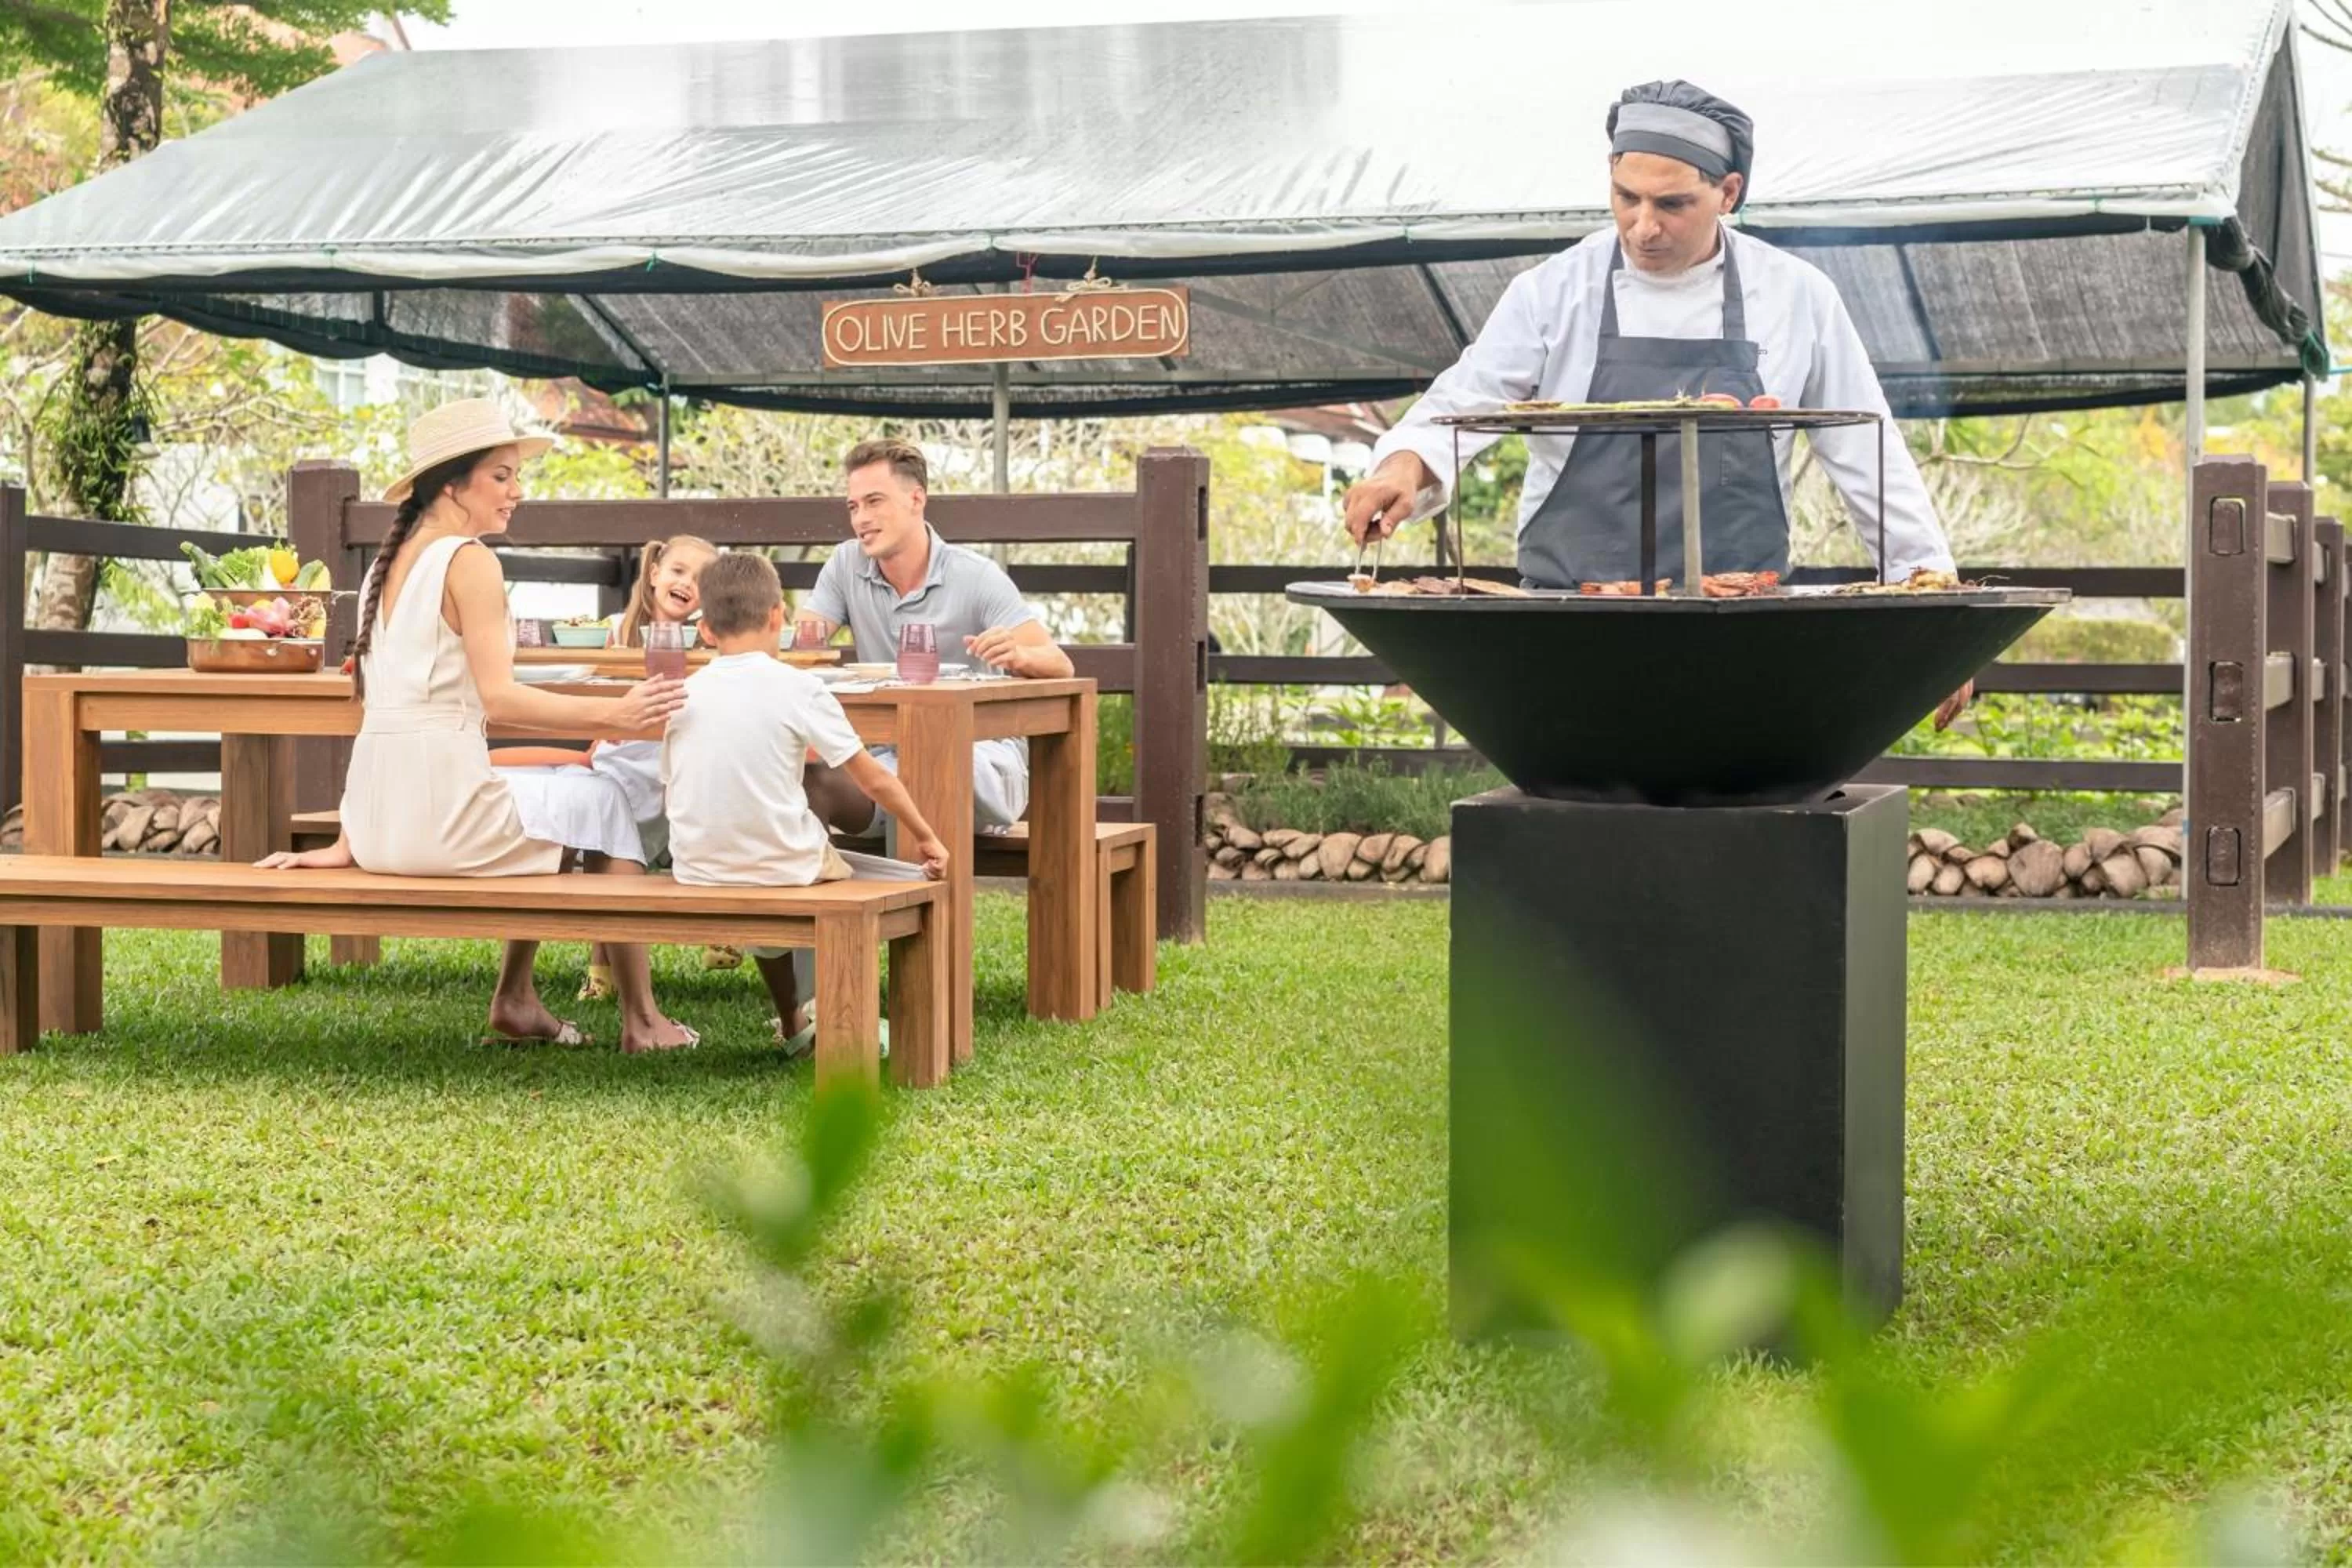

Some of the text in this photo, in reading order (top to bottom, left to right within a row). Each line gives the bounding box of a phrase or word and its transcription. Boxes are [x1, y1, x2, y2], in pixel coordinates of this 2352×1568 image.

[836, 304, 1180, 351] OLIVE HERB GARDEN
